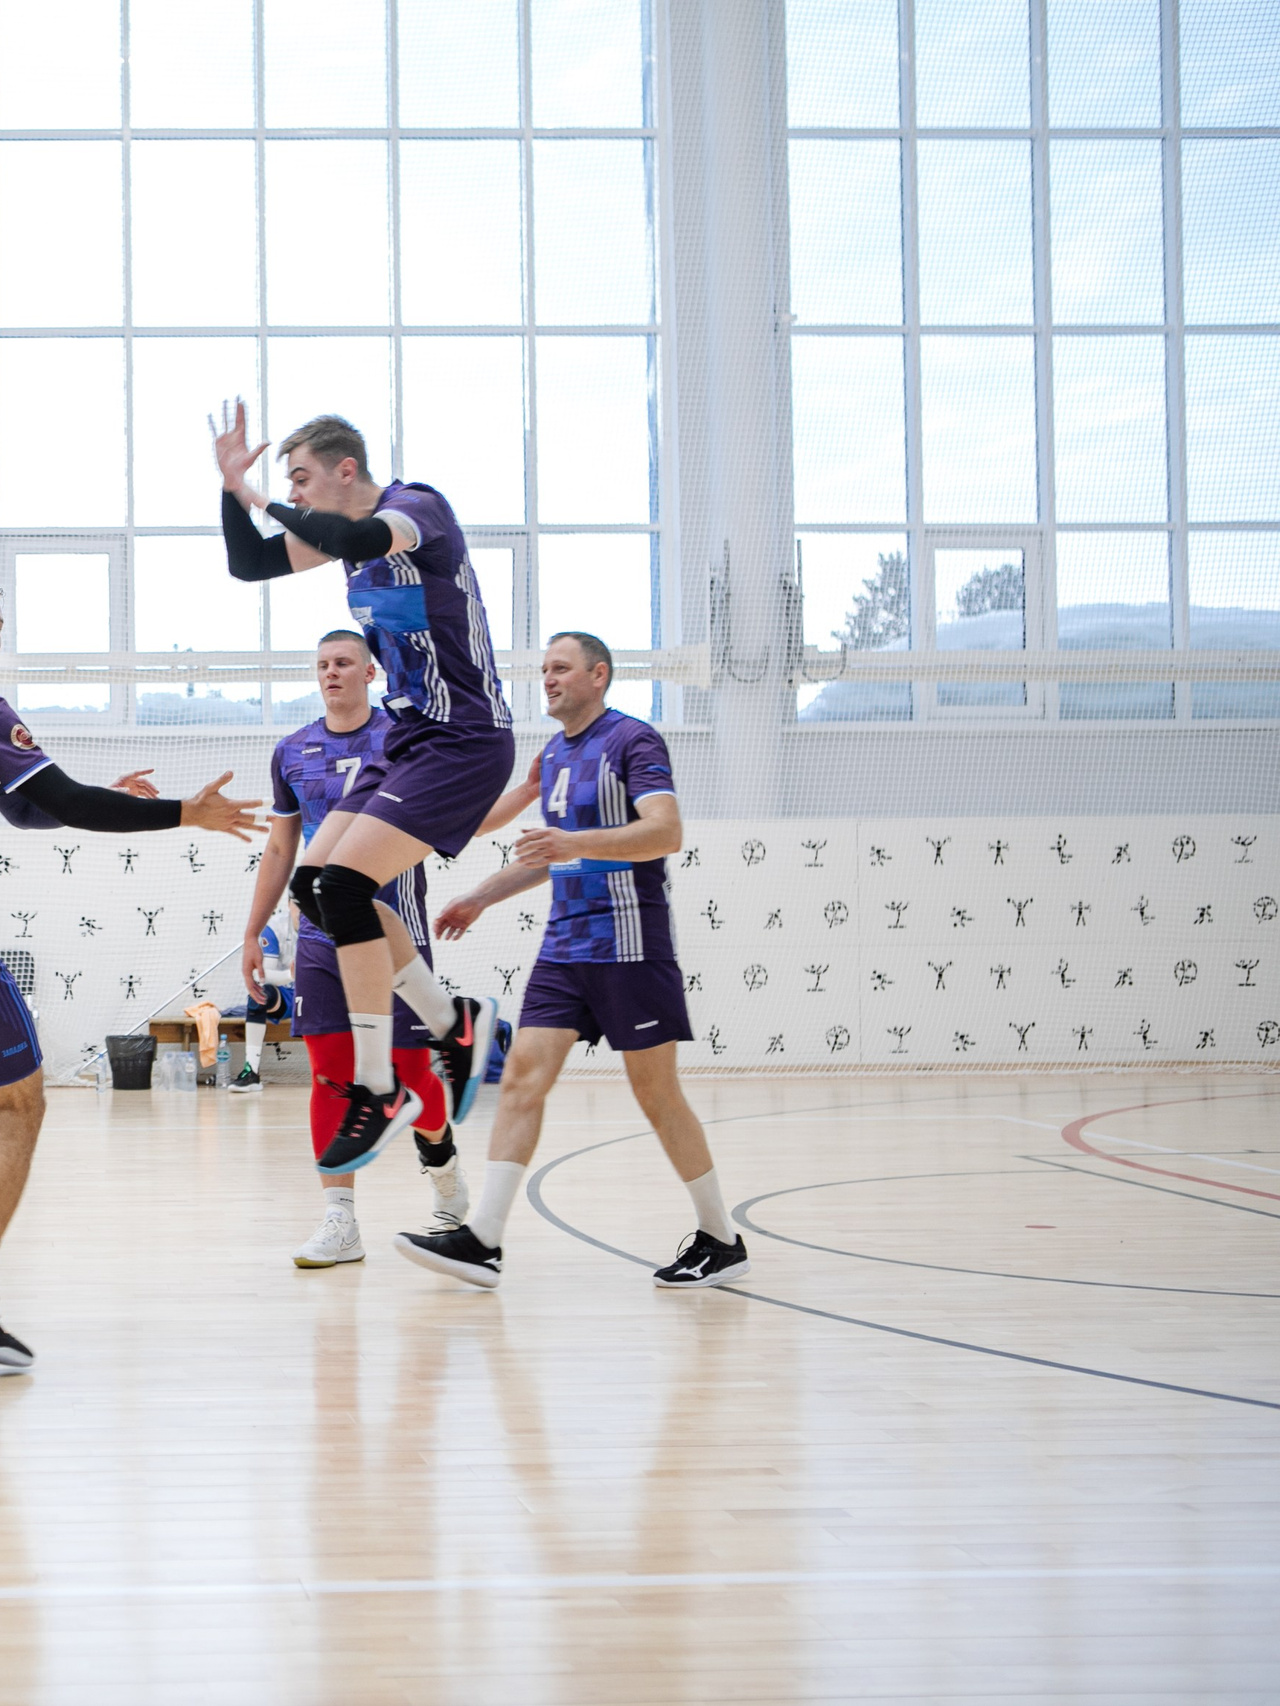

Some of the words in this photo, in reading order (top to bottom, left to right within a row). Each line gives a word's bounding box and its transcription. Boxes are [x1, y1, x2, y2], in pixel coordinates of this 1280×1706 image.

[336, 756, 361, 798] 7
[548, 767, 571, 818] 4
[295, 996, 304, 1017] 7
